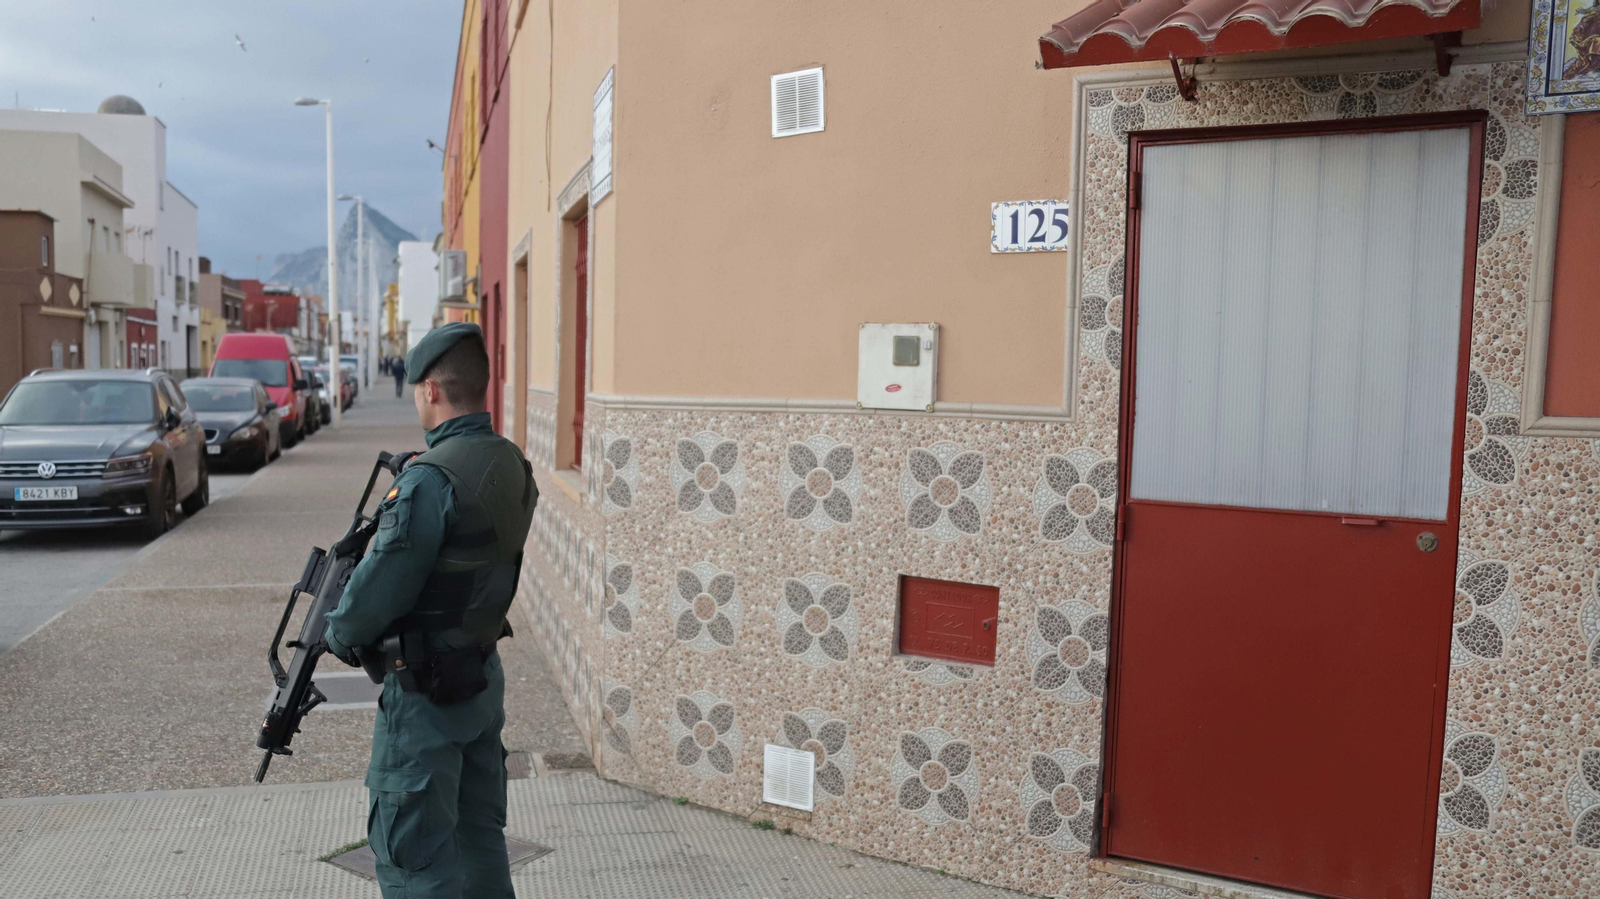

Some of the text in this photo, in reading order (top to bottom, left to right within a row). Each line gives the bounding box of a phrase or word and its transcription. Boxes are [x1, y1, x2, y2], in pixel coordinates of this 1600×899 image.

[1009, 208, 1069, 244] 125
[22, 488, 75, 499] 8421 KBY
